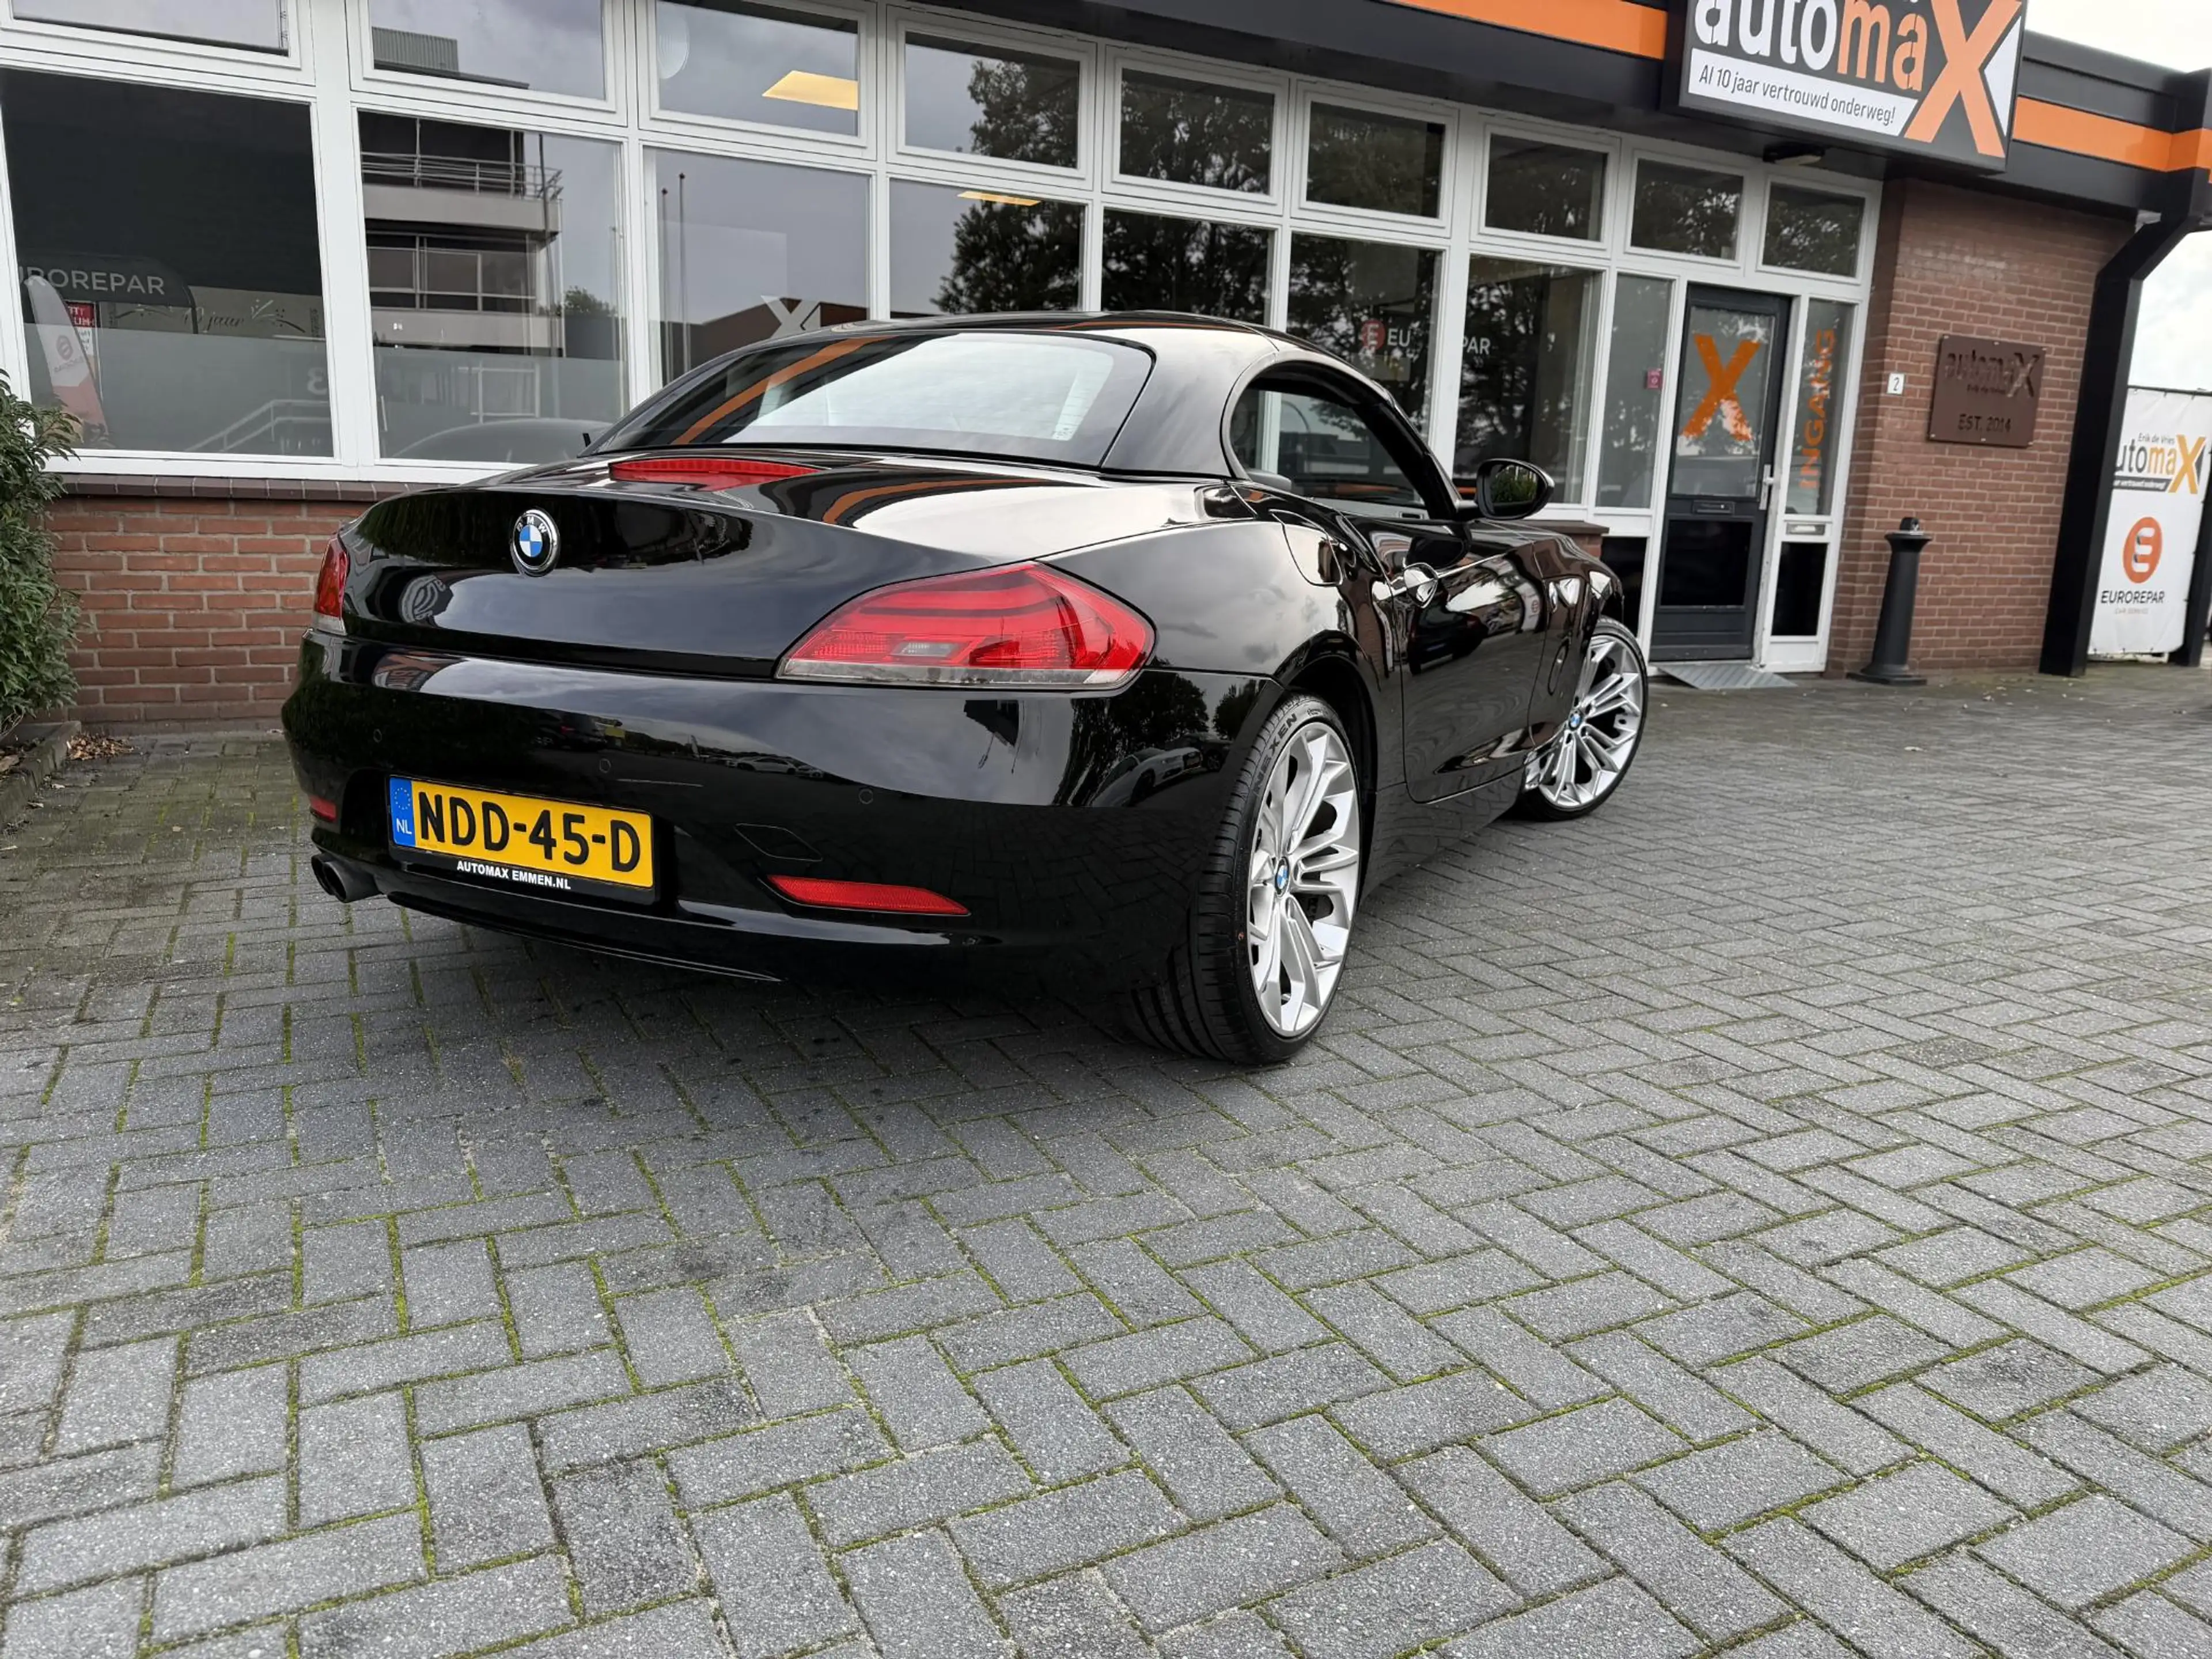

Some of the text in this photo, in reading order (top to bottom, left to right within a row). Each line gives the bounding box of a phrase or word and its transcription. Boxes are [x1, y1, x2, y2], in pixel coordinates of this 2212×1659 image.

[1695, 0, 2020, 158] automaX
[1699, 65, 1895, 126] Al 10 jaar vertrouwd onderweg!
[19, 266, 165, 295] ROREPAR
[1679, 334, 1762, 442] X
[1799, 329, 1836, 489] INGANG
[1893, 377, 1899, 391] 2
[1986, 416, 2011, 433] 2014
[2116, 434, 2206, 494] utomaX
[2101, 590, 2165, 604] EUROREPAR
[1253, 713, 1297, 794] NEXEN
[396, 819, 412, 835] NL
[419, 791, 641, 872] NDD-45-D
[457, 861, 571, 890] AUTOMAX EMMEN.NL
